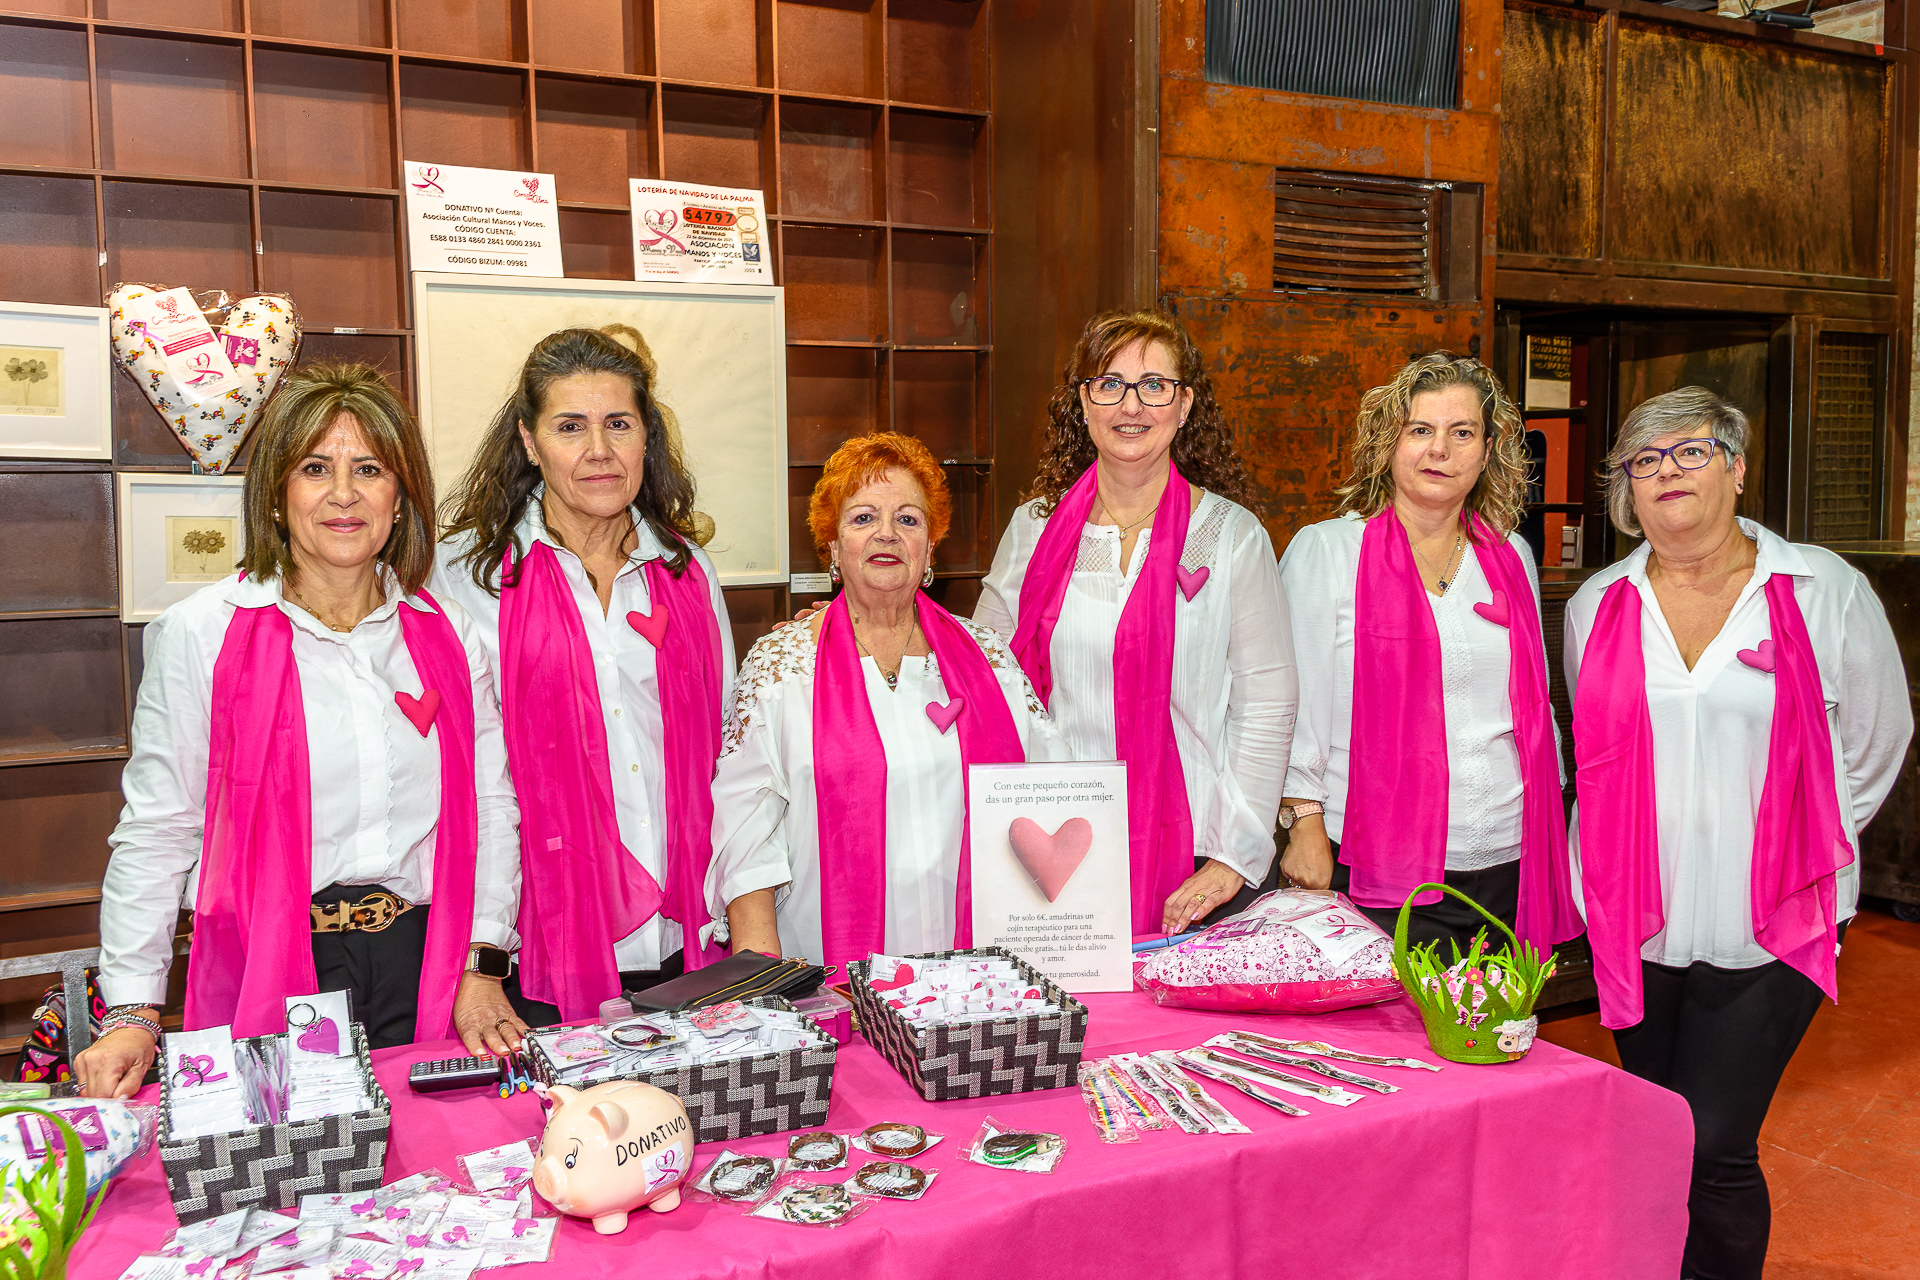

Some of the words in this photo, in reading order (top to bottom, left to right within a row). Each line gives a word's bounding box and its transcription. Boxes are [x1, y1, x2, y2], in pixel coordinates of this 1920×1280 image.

[637, 185, 668, 194] LOTERÍA
[669, 188, 678, 196] DE
[678, 189, 710, 199] NAVIDAD
[710, 193, 719, 201] DE
[719, 194, 729, 202] LA
[729, 195, 755, 203] PALMA
[445, 204, 483, 213] DONATIVO
[495, 207, 523, 216] Cuenta:
[685, 208, 734, 223] 54797
[422, 212, 461, 222] Asociación
[462, 215, 491, 224] Cultural
[491, 217, 516, 226] Manos
[522, 219, 546, 228] Voces.
[454, 224, 485, 234] CÓDIGO
[485, 227, 517, 236] CUENTA:
[430, 234, 448, 242] ES88
[448, 235, 467, 243] 0133
[468, 236, 486, 244] 4860
[487, 237, 505, 246] 2841
[505, 239, 524, 247] 0000
[524, 240, 542, 248] 2361
[684, 249, 711, 258] MANOS
[447, 254, 478, 265] CÓDIGO
[478, 258, 506, 266] BIZUM:
[506, 259, 528, 267] 09981
[993, 781, 1012, 791] Con
[1013, 782, 1031, 791] este
[1032, 781, 1069, 792] pequeño
[1070, 780, 1105, 789] corazón,
[985, 794, 1000, 804] das
[1014, 796, 1034, 806] gran
[1035, 795, 1055, 805] paso
[1056, 795, 1071, 805] por
[1072, 793, 1090, 802] otra
[1091, 792, 1115, 803] mujer.
[1021, 913, 1036, 921] solo
[1048, 912, 1084, 921] amadrinas
[1024, 923, 1063, 934] terapéutico
[1063, 924, 1079, 933] para
[994, 935, 1022, 945] paciente
[1023, 934, 1050, 944] operada
[1051, 933, 1060, 941] de
[1060, 933, 1082, 941] cáncer
[1083, 932, 1092, 940] de
[1013, 944, 1034, 953] recibe
[1059, 943, 1067, 952] tú
[1075, 942, 1088, 951] das
[1088, 942, 1107, 951] alivio
[1058, 969, 1101, 980] generosidad.
[616, 1115, 687, 1167] DONATIVO
